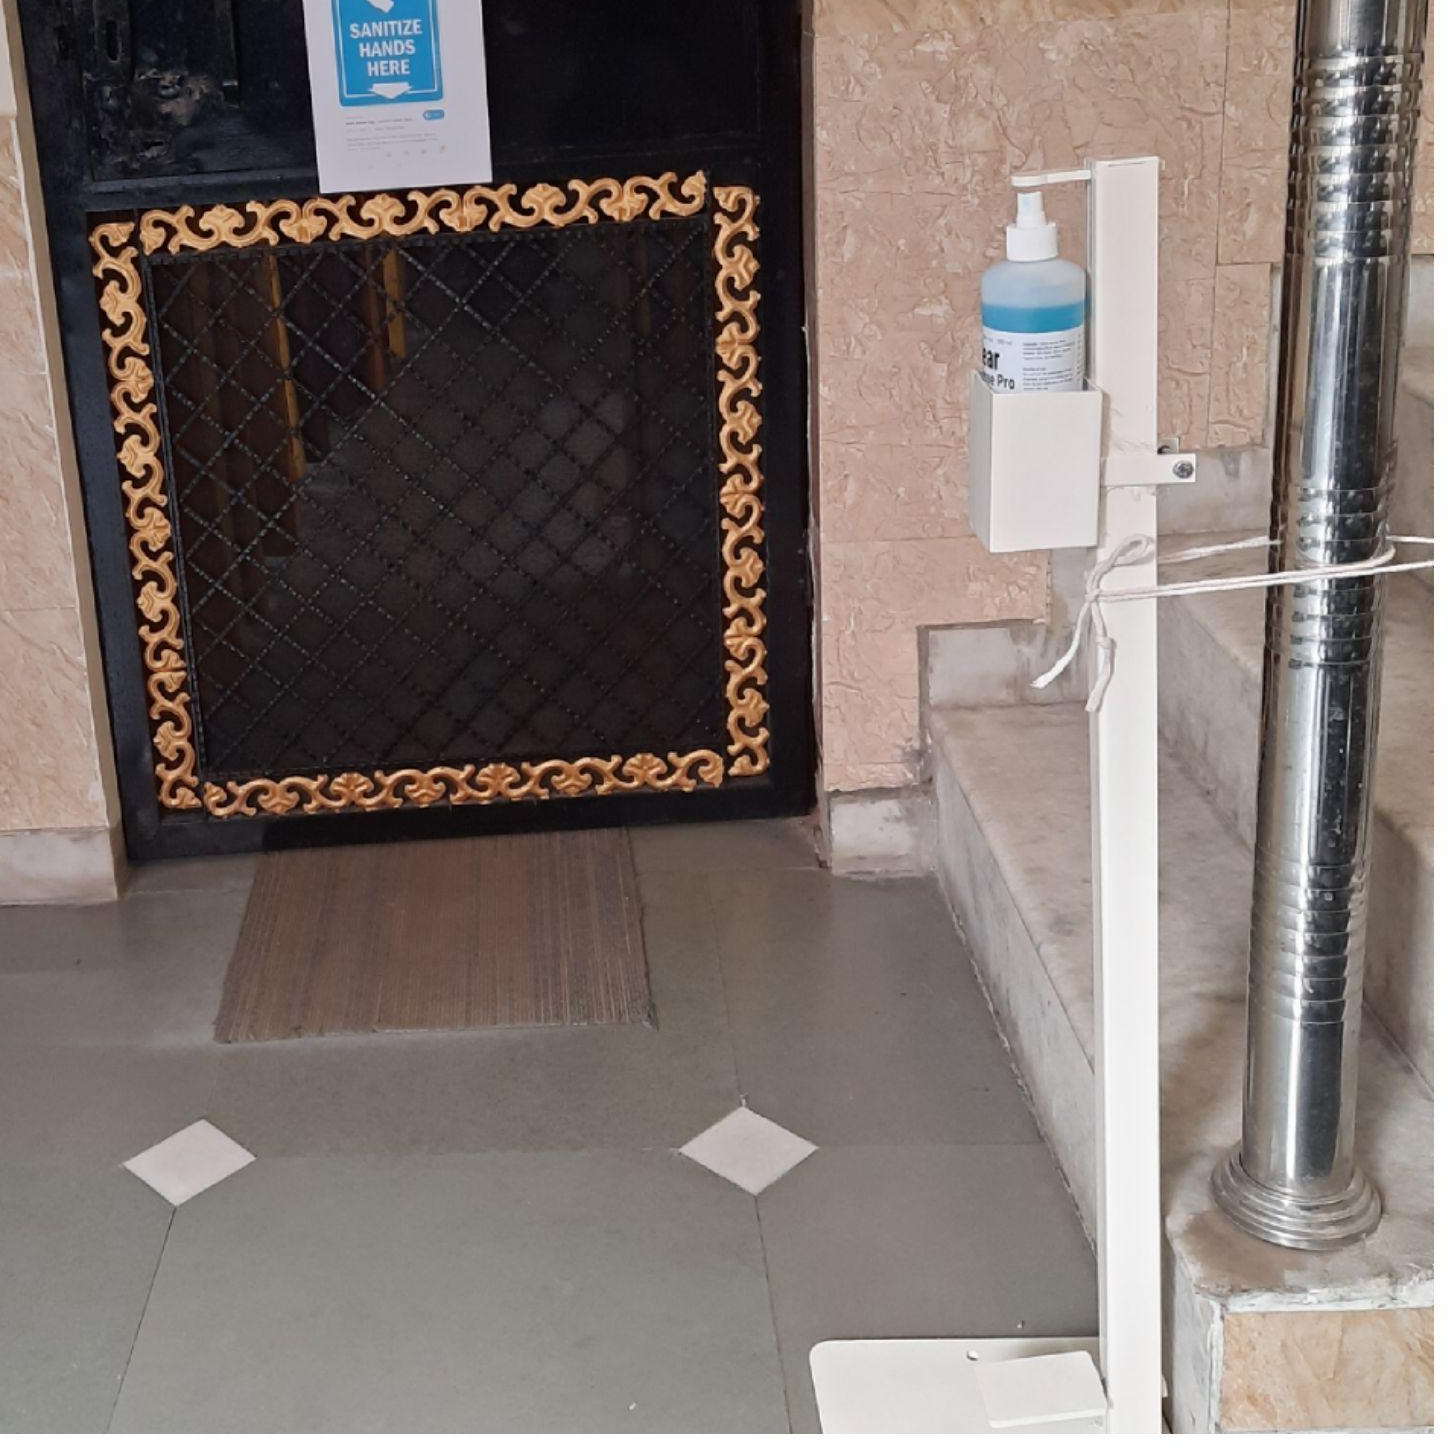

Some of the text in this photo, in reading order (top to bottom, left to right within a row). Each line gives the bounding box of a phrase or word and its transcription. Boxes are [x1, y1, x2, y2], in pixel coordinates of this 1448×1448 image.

[349, 19, 422, 39] SANITIZE
[359, 39, 416, 58] HANDS
[367, 59, 410, 77] HERE
